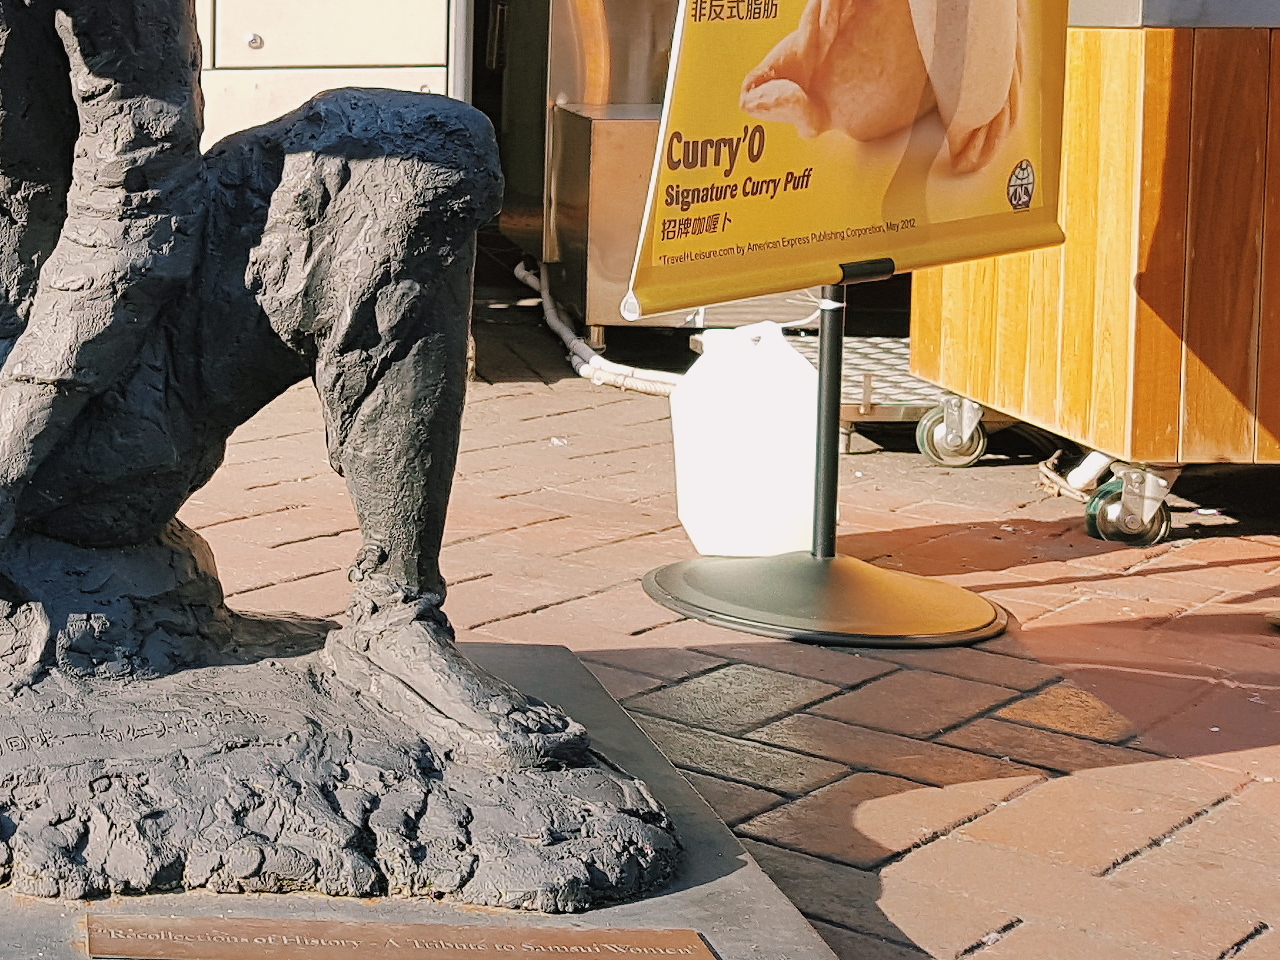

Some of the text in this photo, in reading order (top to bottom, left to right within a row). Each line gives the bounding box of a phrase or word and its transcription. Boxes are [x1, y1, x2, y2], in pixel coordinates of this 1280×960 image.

[666, 124, 765, 178] Curry'O
[665, 167, 813, 212] Signature Curry Puff
[736, 244, 745, 256] by
[747, 240, 780, 252] American
[781, 236, 810, 248] Express
[811, 229, 845, 243] Publishing
[886, 221, 900, 233] May
[901, 218, 916, 230] 2012
[253, 934, 279, 945] of
[282, 934, 361, 949] History
[384, 938, 400, 948] A
[407, 937, 489, 951] Tribute
[495, 942, 515, 951] to
[520, 941, 601, 953] Samsui
